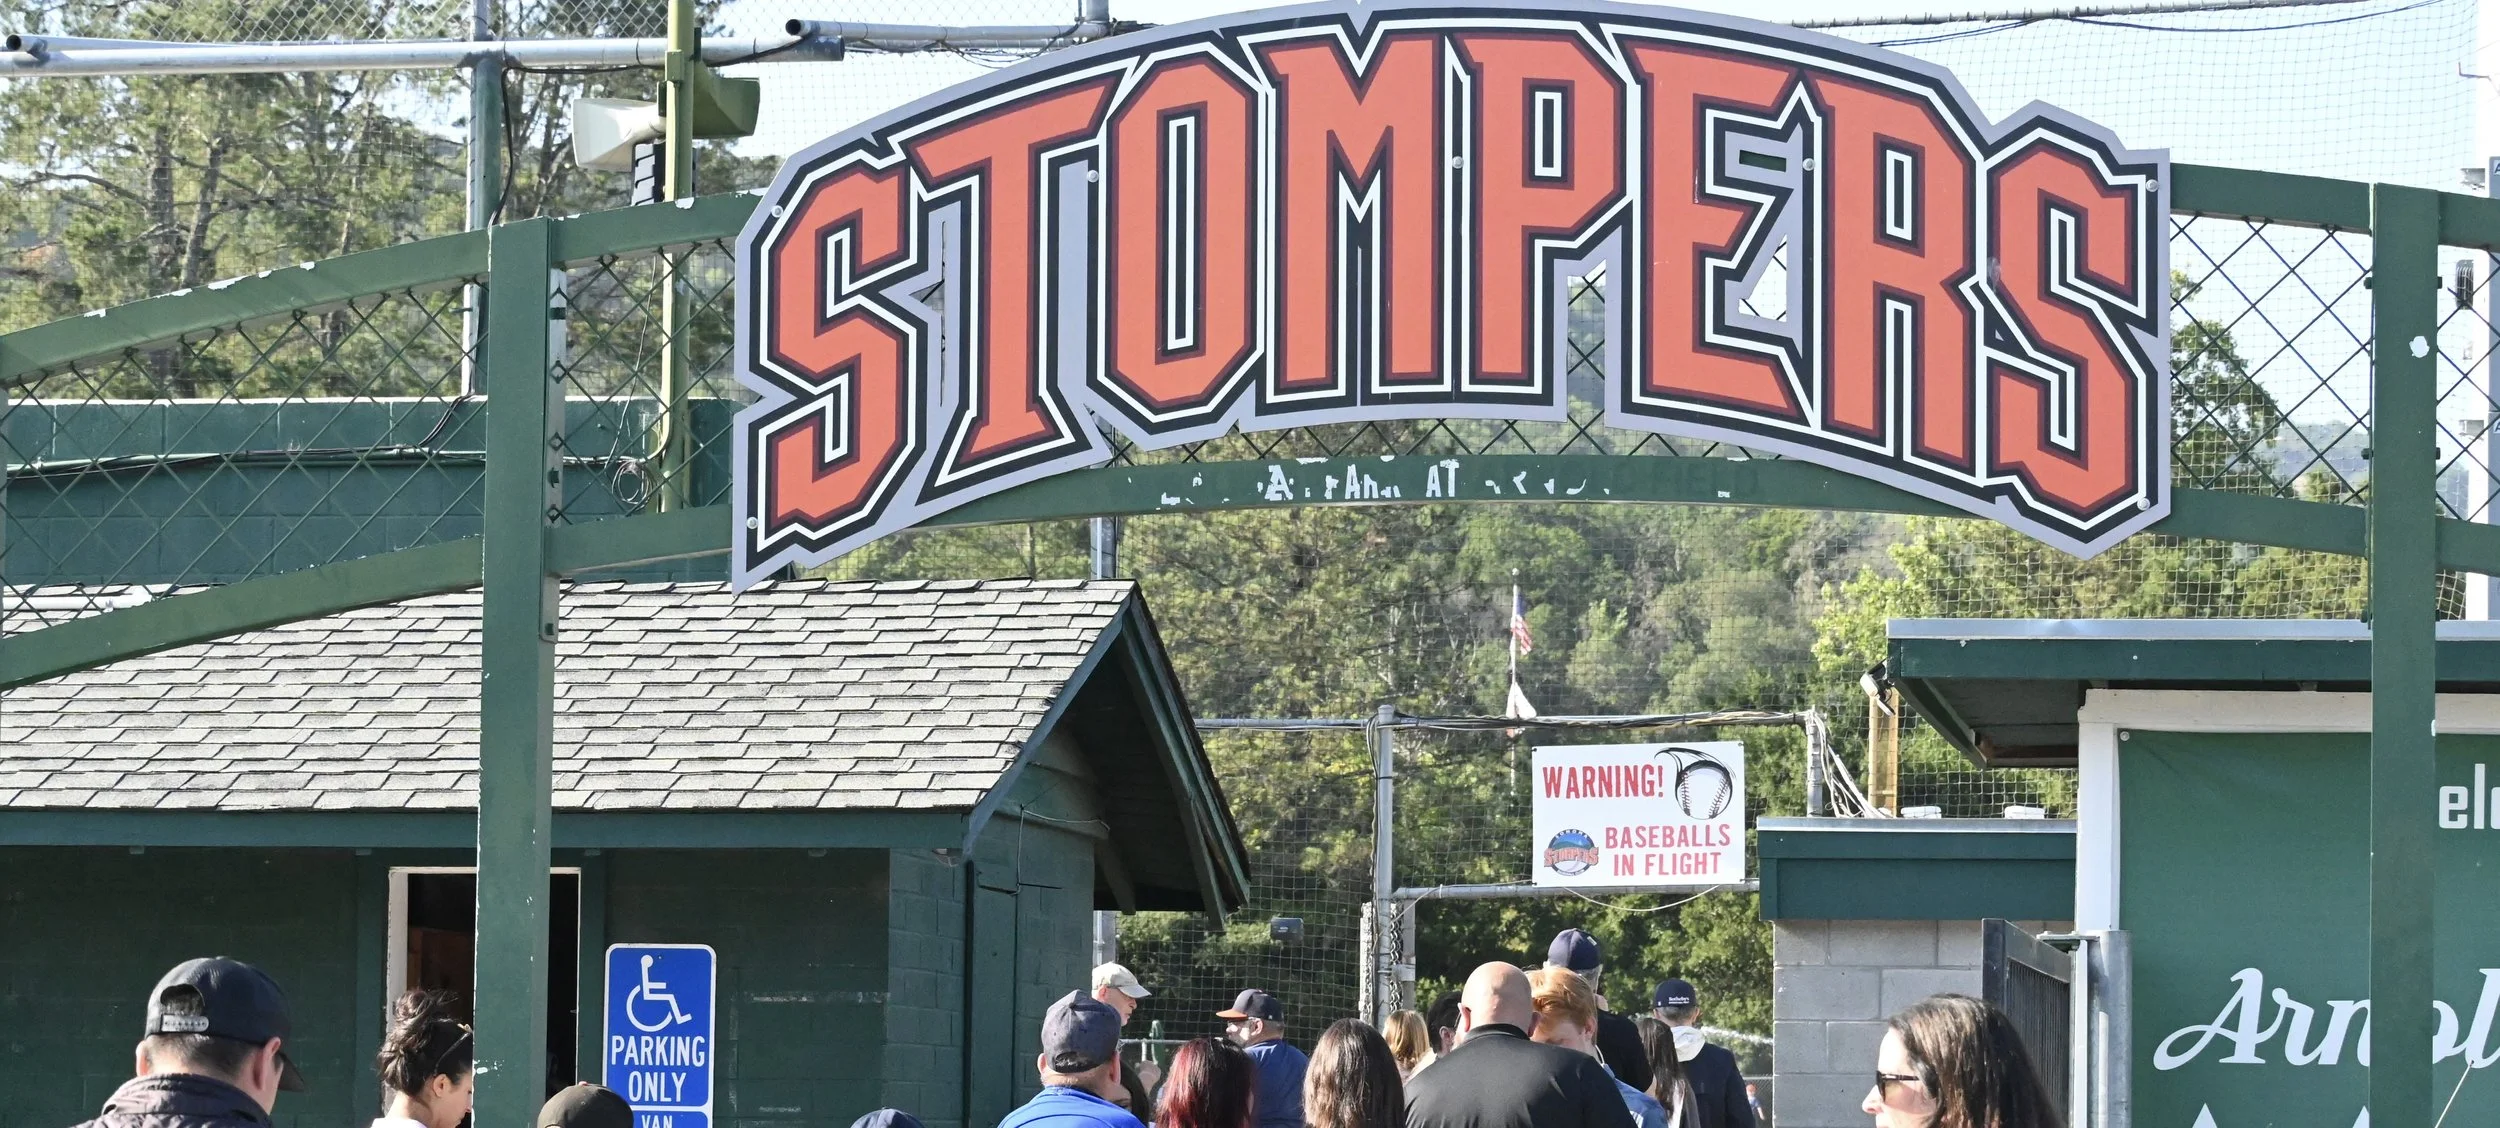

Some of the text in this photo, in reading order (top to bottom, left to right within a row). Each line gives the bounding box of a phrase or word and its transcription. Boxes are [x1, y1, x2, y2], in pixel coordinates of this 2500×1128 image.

[748, 22, 2156, 548] STOMPERS
[1543, 764, 1664, 799] WARNING!
[1605, 824, 1731, 849] BASEBALLS
[1613, 852, 1722, 876] IN FLIGHT
[611, 1035, 705, 1067] PARKING
[628, 1070, 687, 1102] ONLY
